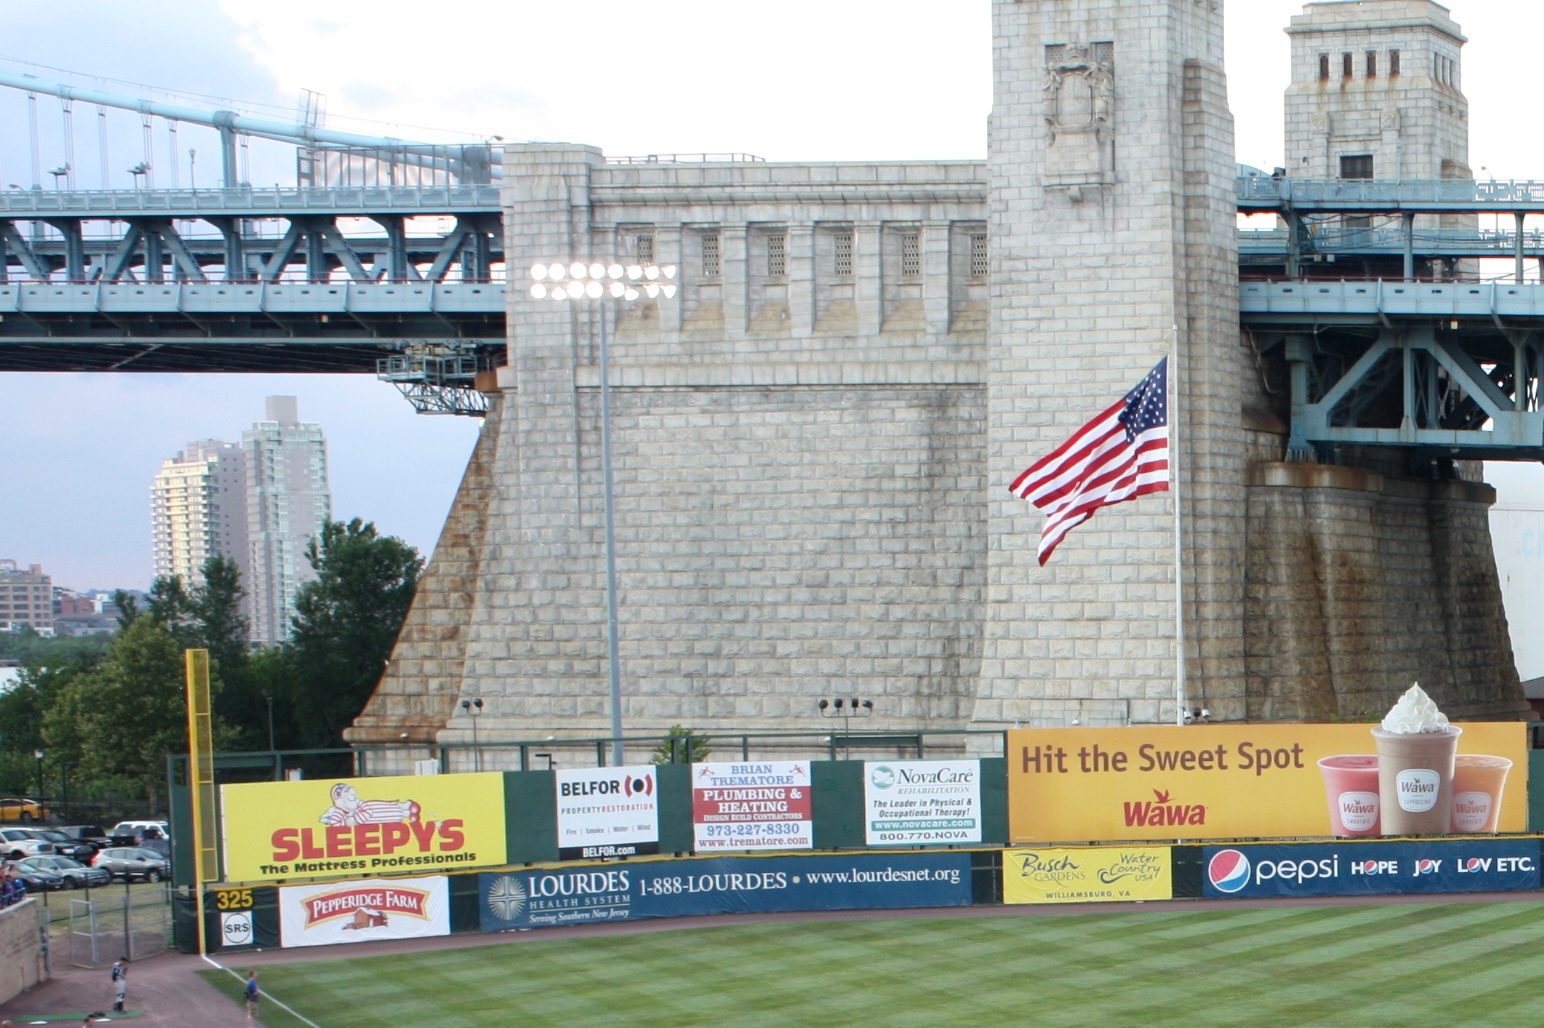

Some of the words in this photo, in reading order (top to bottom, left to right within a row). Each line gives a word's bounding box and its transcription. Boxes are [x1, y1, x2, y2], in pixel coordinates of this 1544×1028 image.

[1022, 745, 1068, 773] Hit
[1077, 744, 1128, 772] the
[1139, 743, 1228, 771] Sweet
[1238, 742, 1304, 776] Spot
[731, 765, 772, 775] BRIAN
[897, 768, 972, 784] NovaCare
[711, 776, 794, 786] TREMATORE
[1401, 781, 1435, 793] Wawa
[561, 780, 620, 796] BELFOR
[703, 788, 786, 801] PLUMBING
[790, 788, 802, 799] &
[897, 787, 970, 795] REHABILITATION
[718, 801, 789, 814] HEATING
[873, 800, 888, 808] The
[890, 799, 917, 808] Leader
[919, 798, 927, 807] in
[929, 797, 965, 809] Physical
[966, 797, 973, 806] &
[1343, 802, 1375, 814] Wawa
[1456, 802, 1487, 814] Wawa
[704, 814, 729, 822] DESIGN
[753, 812, 803, 821] CONTRACTORS
[878, 807, 933, 819] Occupational
[934, 806, 971, 818] Therapy!
[1123, 801, 1206, 828] Wawa
[585, 826, 604, 835] Smoke
[613, 825, 628, 833] Water
[637, 824, 651, 832] Wind
[875, 818, 973, 828] www.novacare.com
[707, 823, 800, 837] 973-227-8330
[879, 830, 968, 841] 800.770.NOVA
[271, 819, 465, 861] SLEEPYS
[699, 836, 809, 847] www.trematore.com
[583, 845, 635, 858] BELFOR.com
[260, 864, 289, 875] The
[294, 859, 366, 873] Mattress
[371, 852, 476, 868] Professionals
[1015, 853, 1079, 877] Busch
[1120, 853, 1159, 864] Water
[1110, 863, 1161, 878] Country
[1256, 854, 1338, 885] pepsi
[1497, 857, 1535, 873] ETC.
[528, 870, 630, 898] LOURDES
[640, 872, 787, 896] 1-888-LOURDES
[806, 867, 961, 885] www.lourdesnet.org
[1035, 871, 1086, 884] GARDENS
[1135, 874, 1153, 882] USA
[217, 890, 253, 910] 325
[313, 893, 384, 916] PEPPERIDGE
[385, 892, 418, 909] FARM
[530, 897, 579, 909] HEALTH
[585, 895, 631, 905] SYSTEM
[225, 922, 249, 933] SRS
